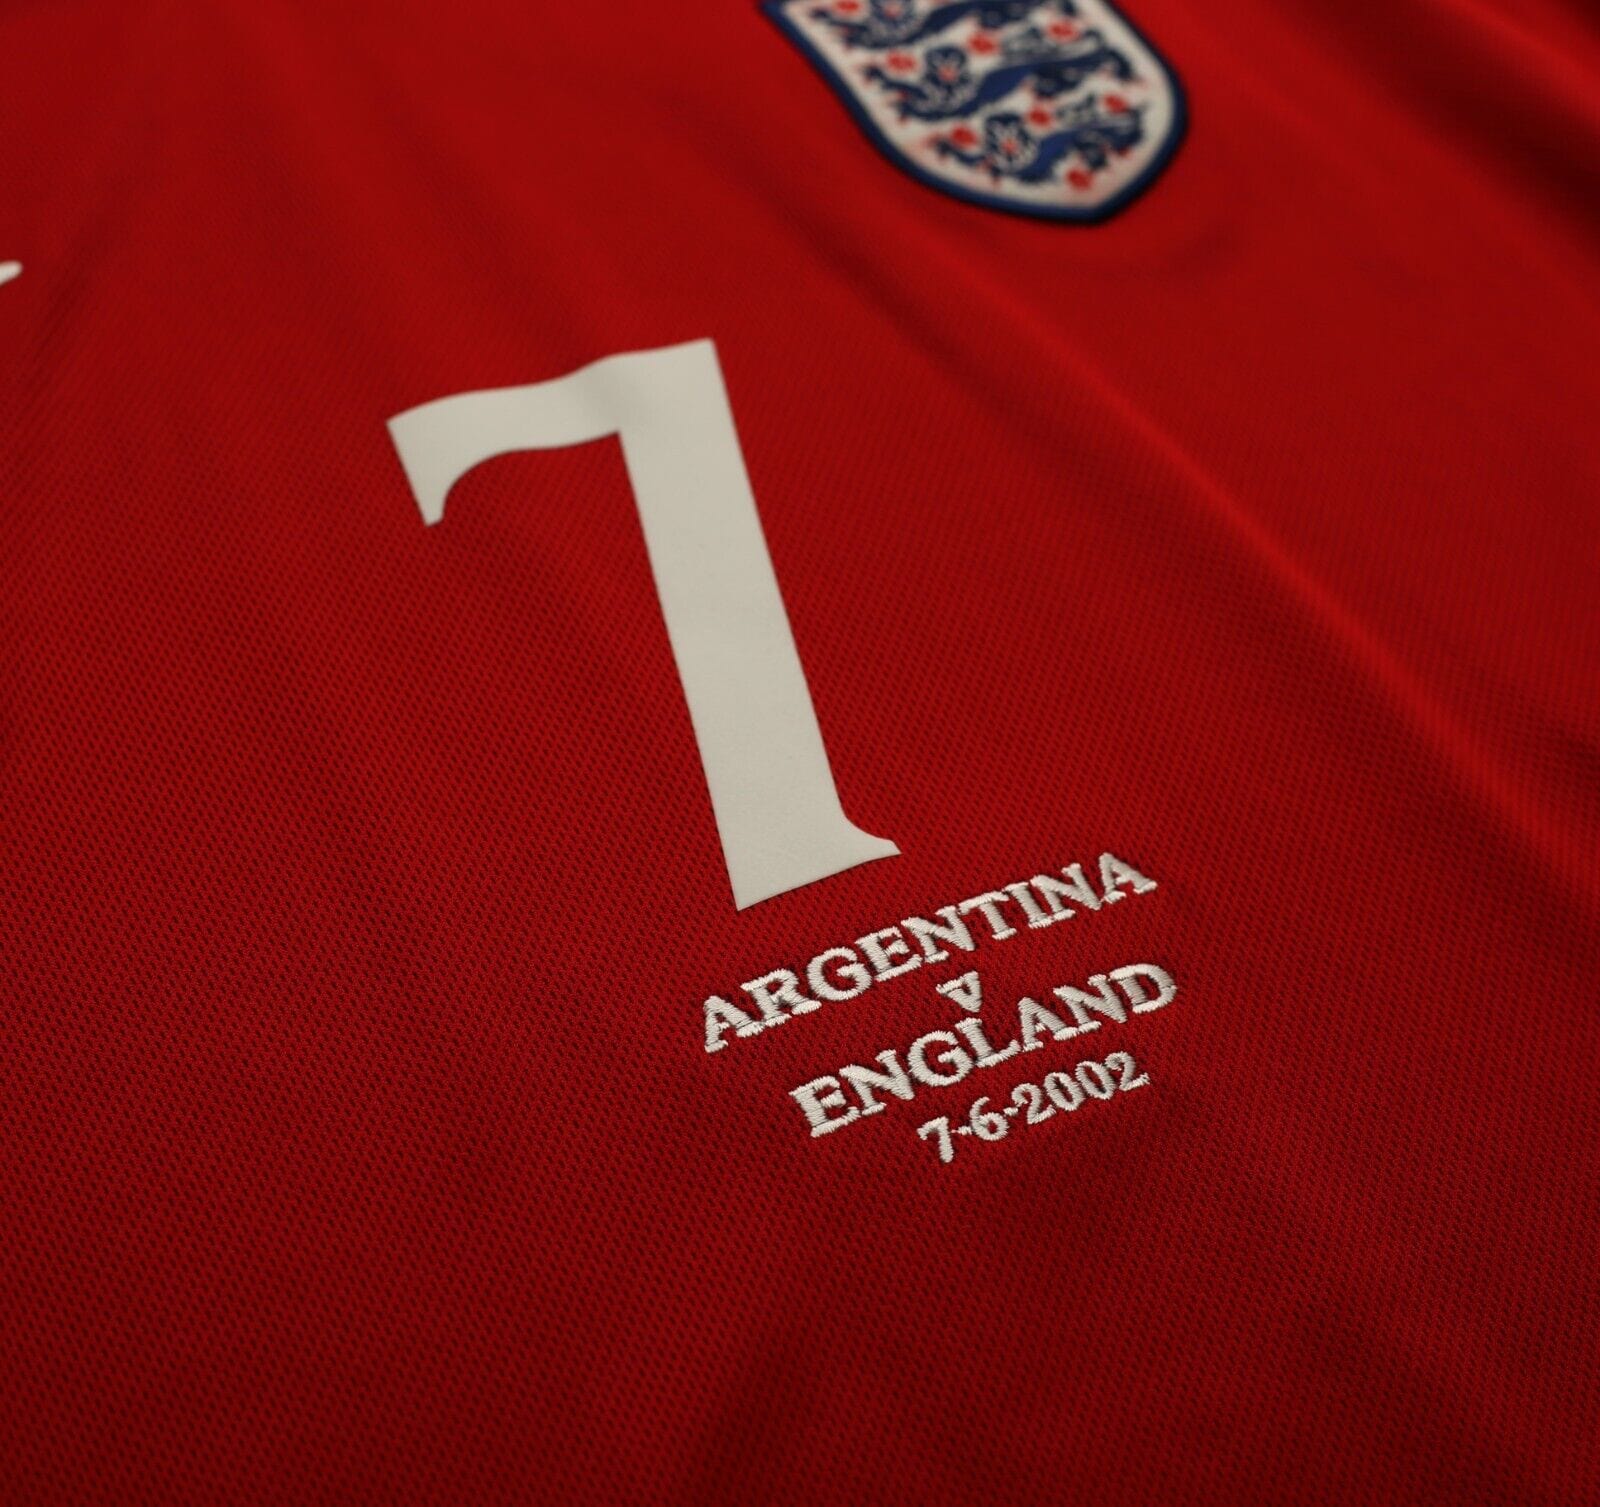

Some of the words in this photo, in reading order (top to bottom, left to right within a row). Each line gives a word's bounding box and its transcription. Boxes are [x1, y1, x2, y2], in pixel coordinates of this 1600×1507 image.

[386, 337, 902, 912] 7
[702, 851, 1158, 1055] ARGENTINA
[788, 962, 1178, 1138] ENGLAND
[916, 1050, 1151, 1164] 7-6-2002
